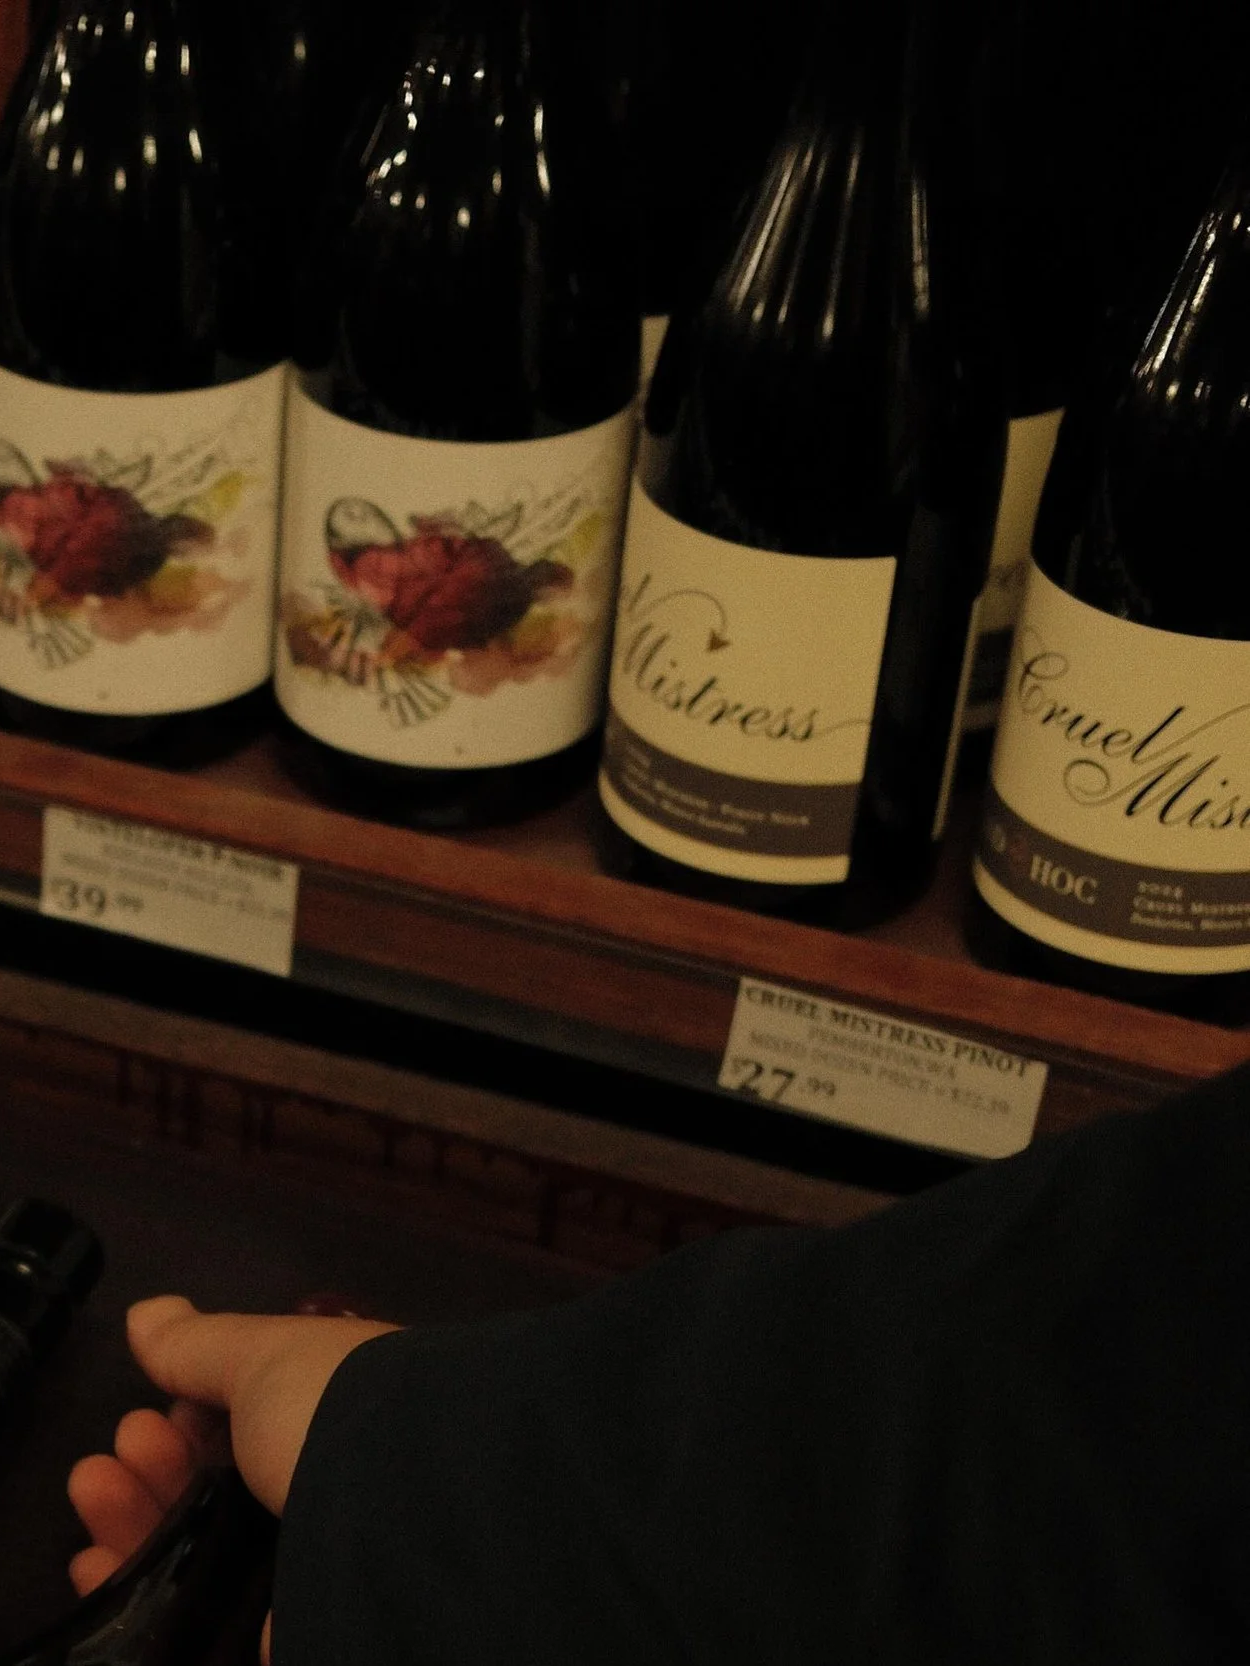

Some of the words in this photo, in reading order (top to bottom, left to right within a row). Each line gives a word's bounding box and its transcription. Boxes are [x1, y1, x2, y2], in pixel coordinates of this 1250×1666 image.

[1014, 645, 1186, 765] Cruel
[745, 985, 823, 1021] CRUEL
[829, 1008, 947, 1055] MISTRESS
[952, 1040, 1031, 1079] PINOT
